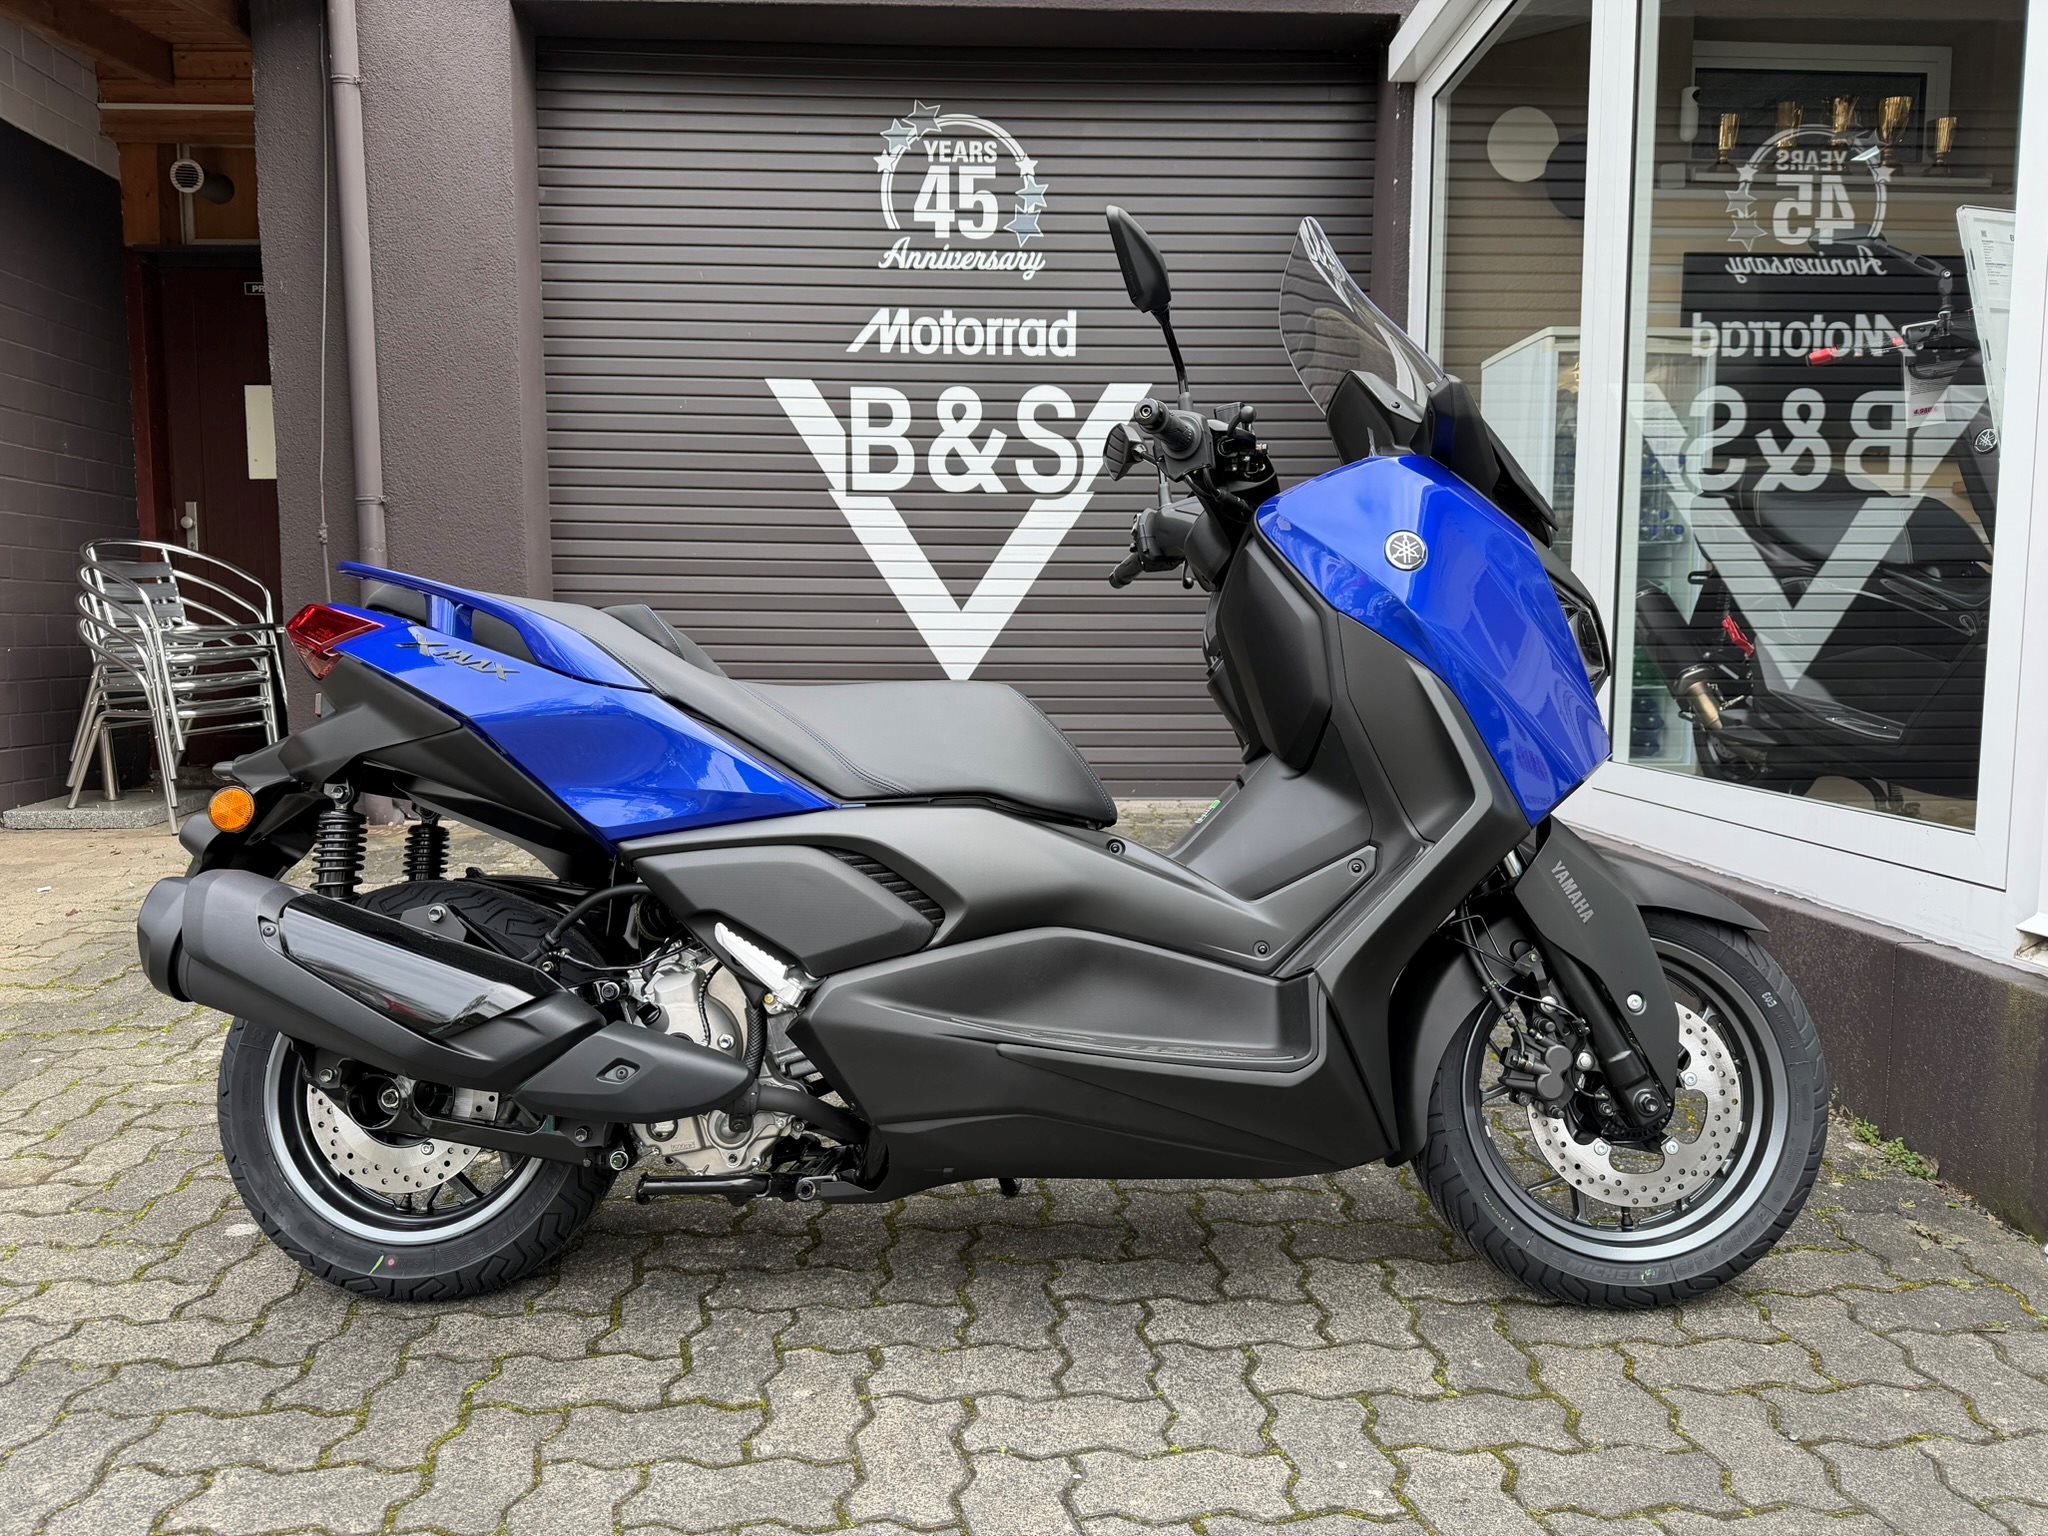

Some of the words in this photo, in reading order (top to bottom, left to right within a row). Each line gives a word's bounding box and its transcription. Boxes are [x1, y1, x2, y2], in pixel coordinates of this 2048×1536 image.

[923, 140, 998, 163] YEARS
[913, 165, 999, 240] 45
[878, 236, 1046, 280] Anniversary
[846, 307, 1077, 357] Motorrad
[850, 384, 1079, 493] B&S
[1551, 860, 1594, 923] YAMAHA
